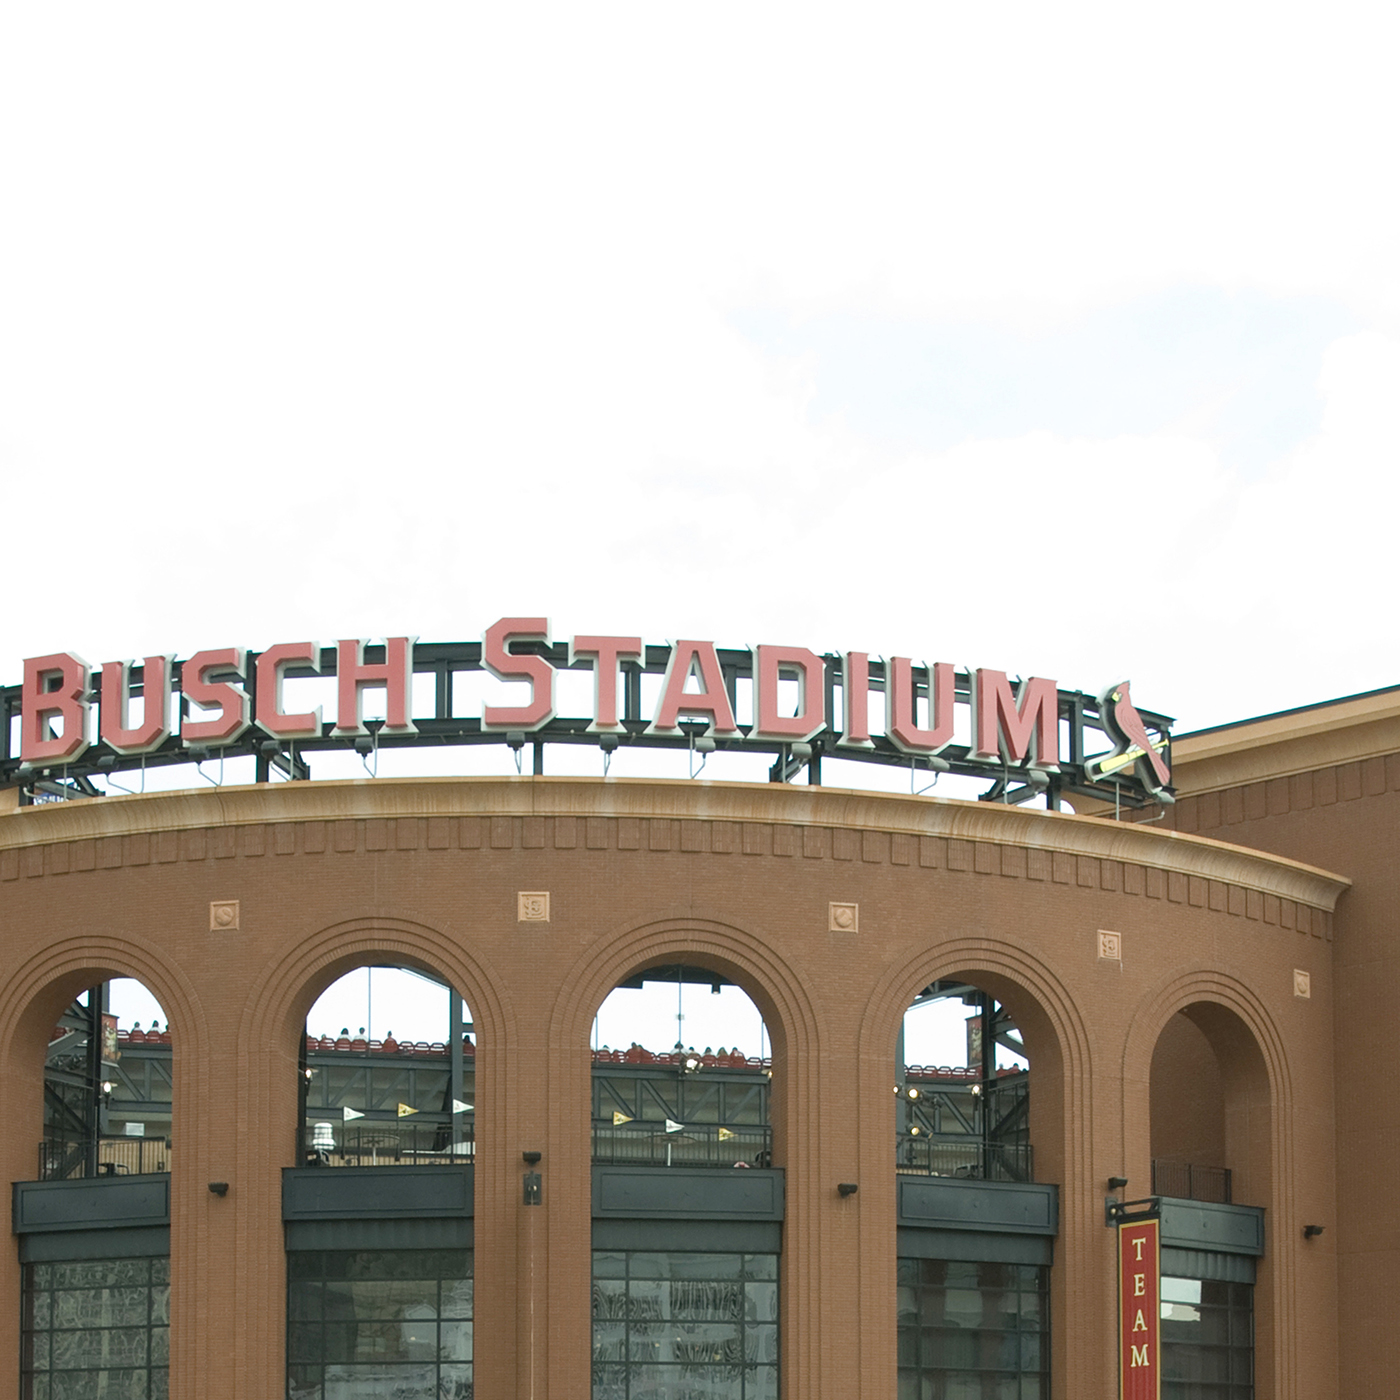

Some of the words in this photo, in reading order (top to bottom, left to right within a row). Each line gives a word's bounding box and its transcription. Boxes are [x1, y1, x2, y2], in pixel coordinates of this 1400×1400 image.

[17, 634, 418, 768] BUSCH
[480, 616, 1063, 773] STADIUM
[1130, 1237, 1150, 1367] TEAM
